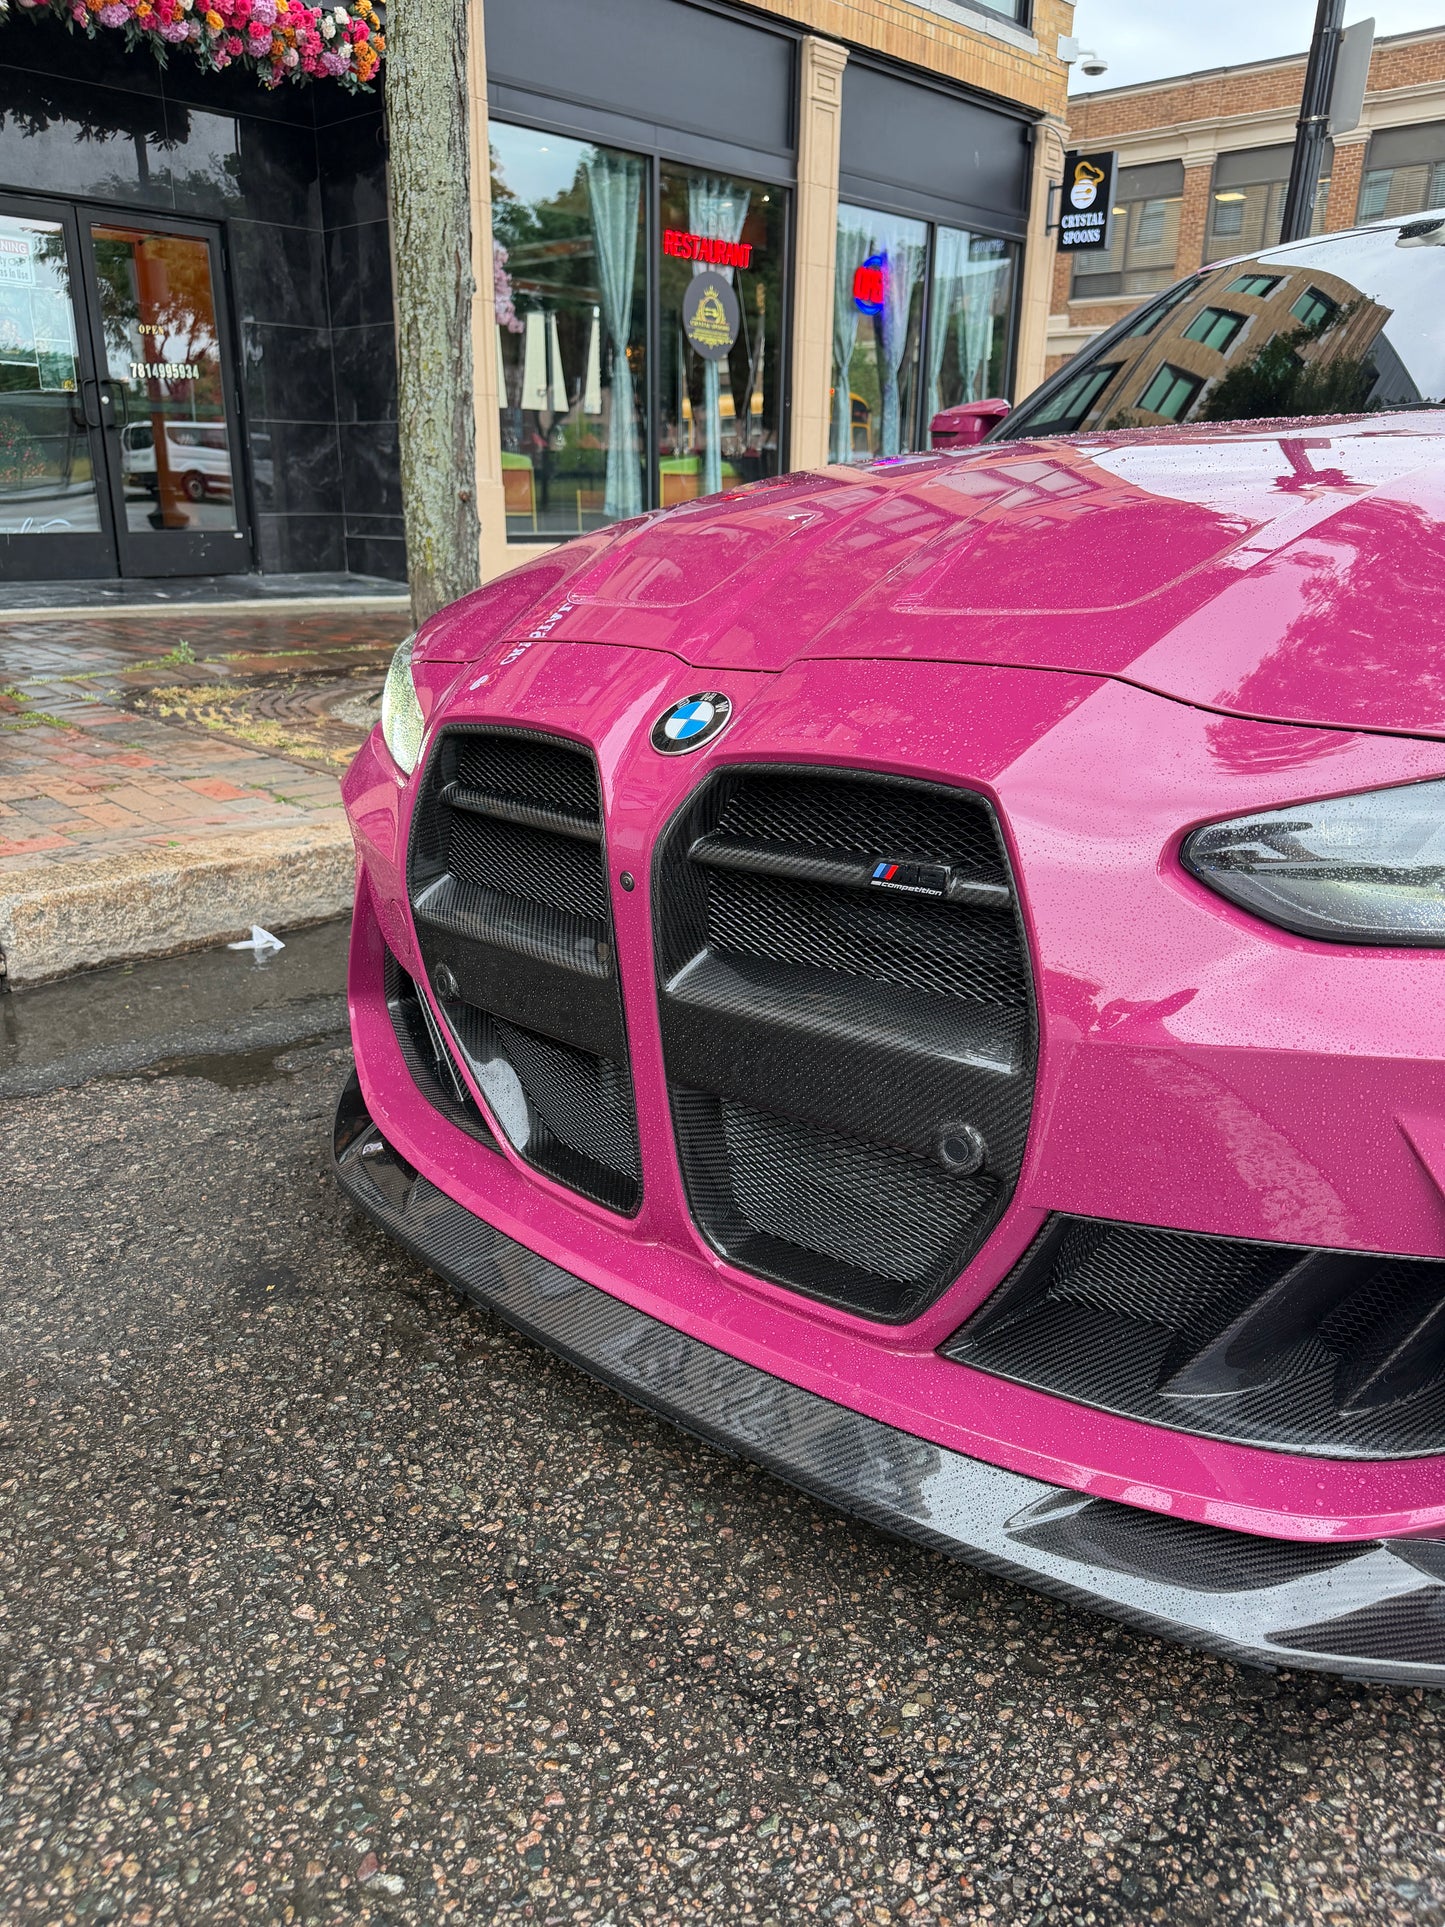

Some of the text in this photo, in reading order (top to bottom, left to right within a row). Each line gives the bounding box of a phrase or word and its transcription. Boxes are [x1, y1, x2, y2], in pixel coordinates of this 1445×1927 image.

[1061, 211, 1105, 229] CRYSTAL
[1062, 228, 1101, 245] SPOONS
[663, 228, 753, 269] RESTAURANT
[138, 324, 164, 335] OPEN
[130, 362, 199, 380] 7814995934
[677, 692, 729, 713] BMW
[881, 880, 943, 897] competition
